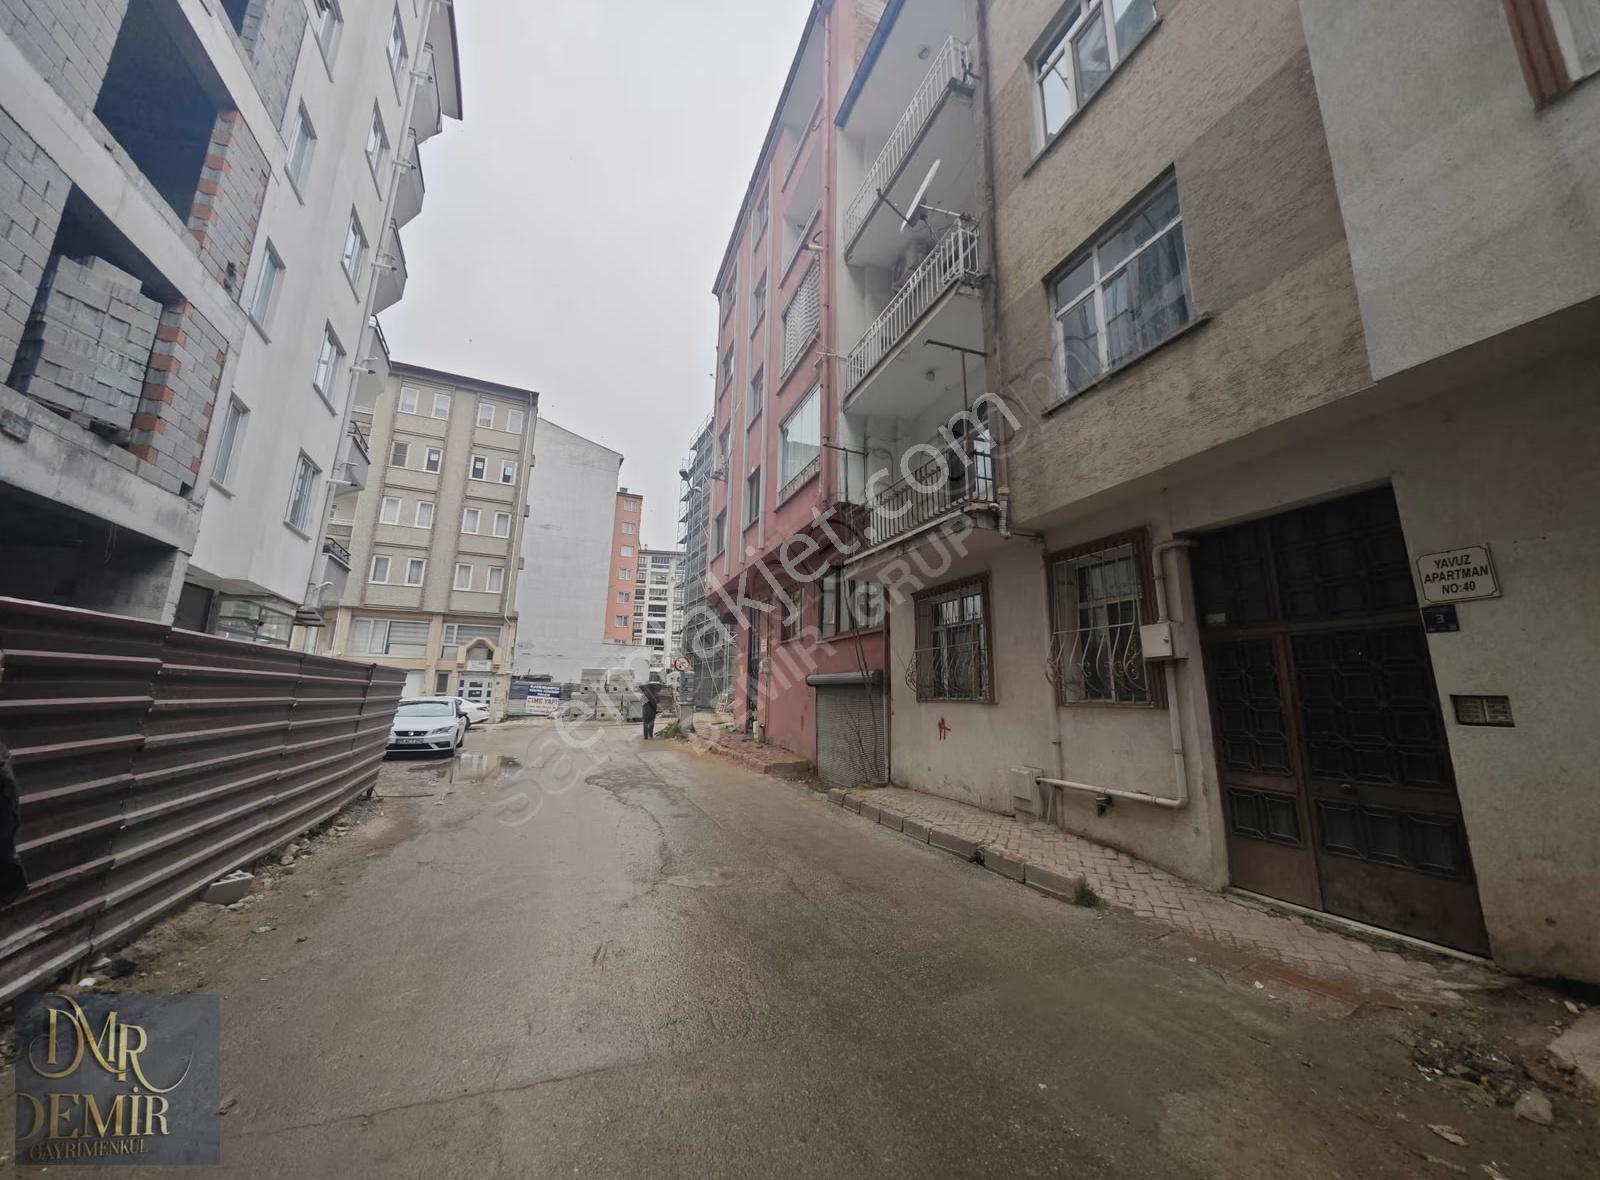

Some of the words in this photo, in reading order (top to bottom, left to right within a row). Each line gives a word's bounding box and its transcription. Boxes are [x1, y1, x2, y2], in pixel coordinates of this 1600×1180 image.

[1434, 554, 1472, 570] YAVUZ
[1424, 565, 1489, 584] APARTMAN
[1442, 581, 1476, 595] NO:40
